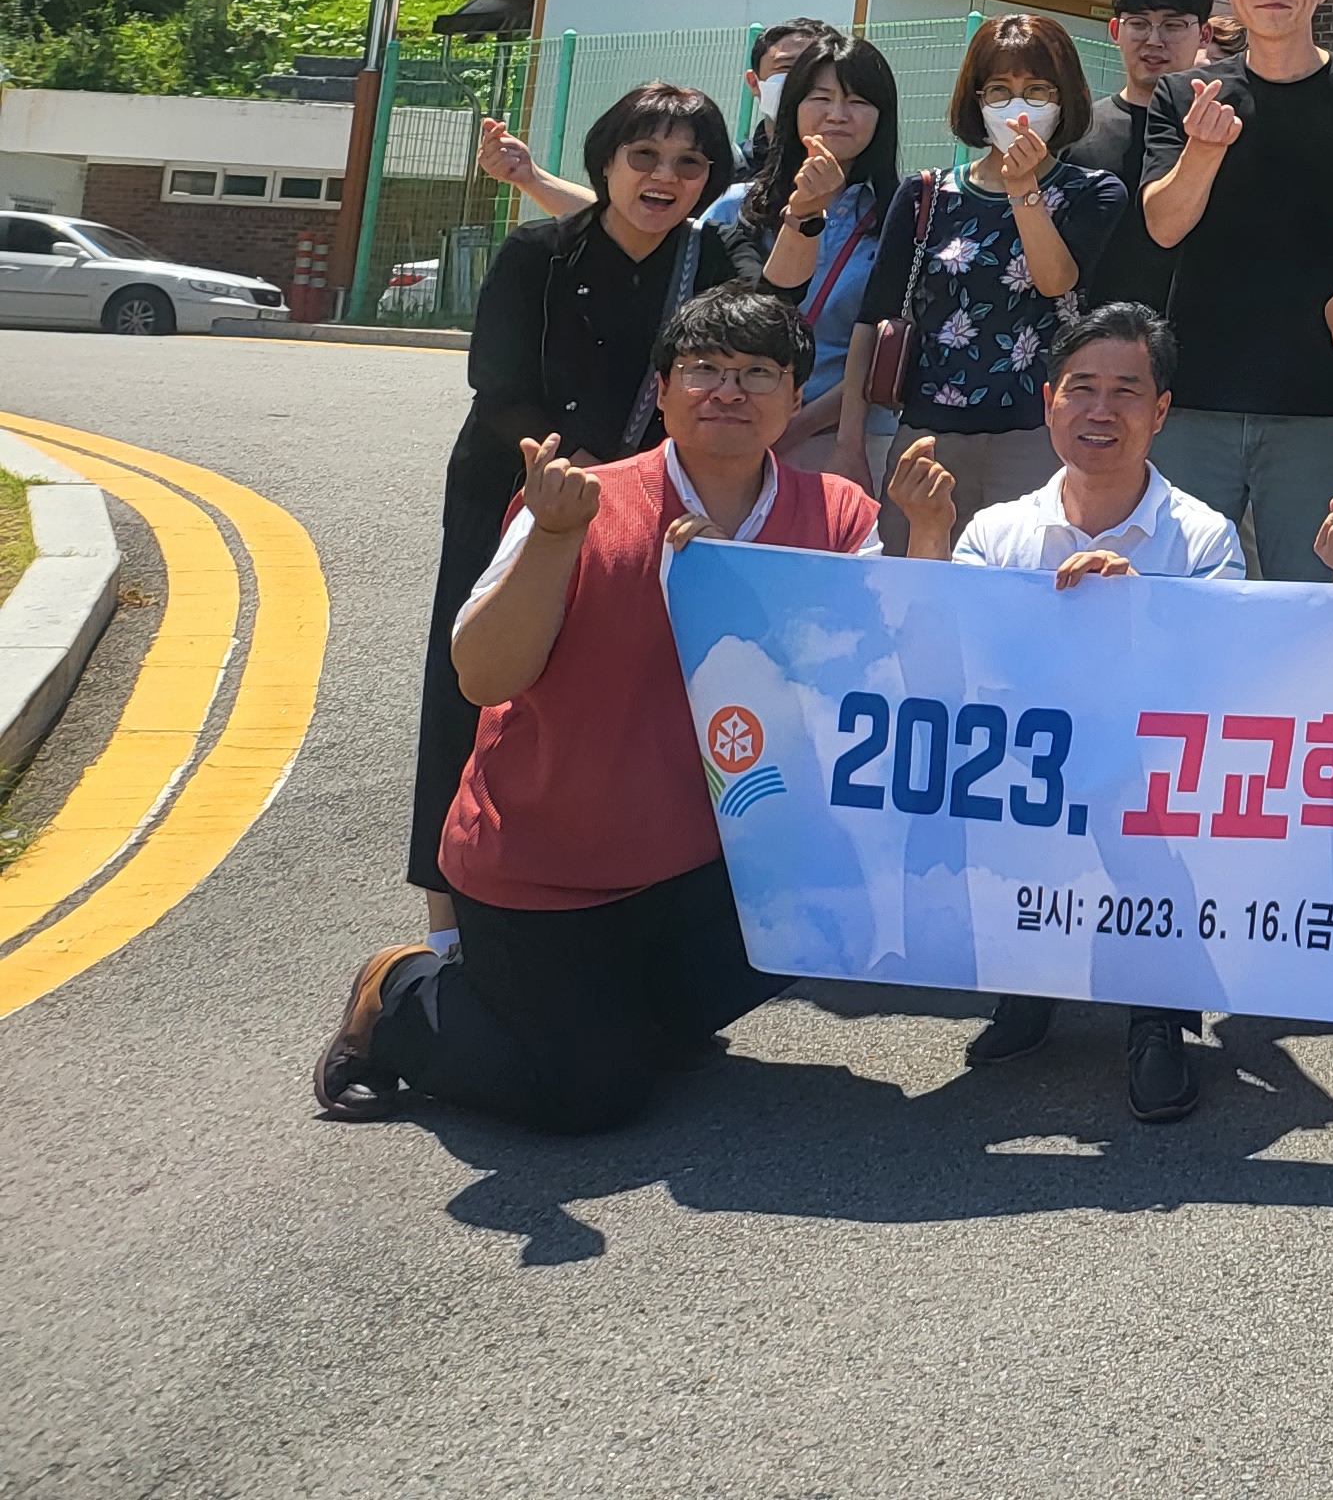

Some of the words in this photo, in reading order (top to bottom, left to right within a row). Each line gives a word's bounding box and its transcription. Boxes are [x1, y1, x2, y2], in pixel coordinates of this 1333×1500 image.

[829, 691, 1089, 837] 2023.
[1016, 885, 1084, 936] 일시:
[1096, 895, 1184, 939] 2023.
[1198, 898, 1227, 940] 6.
